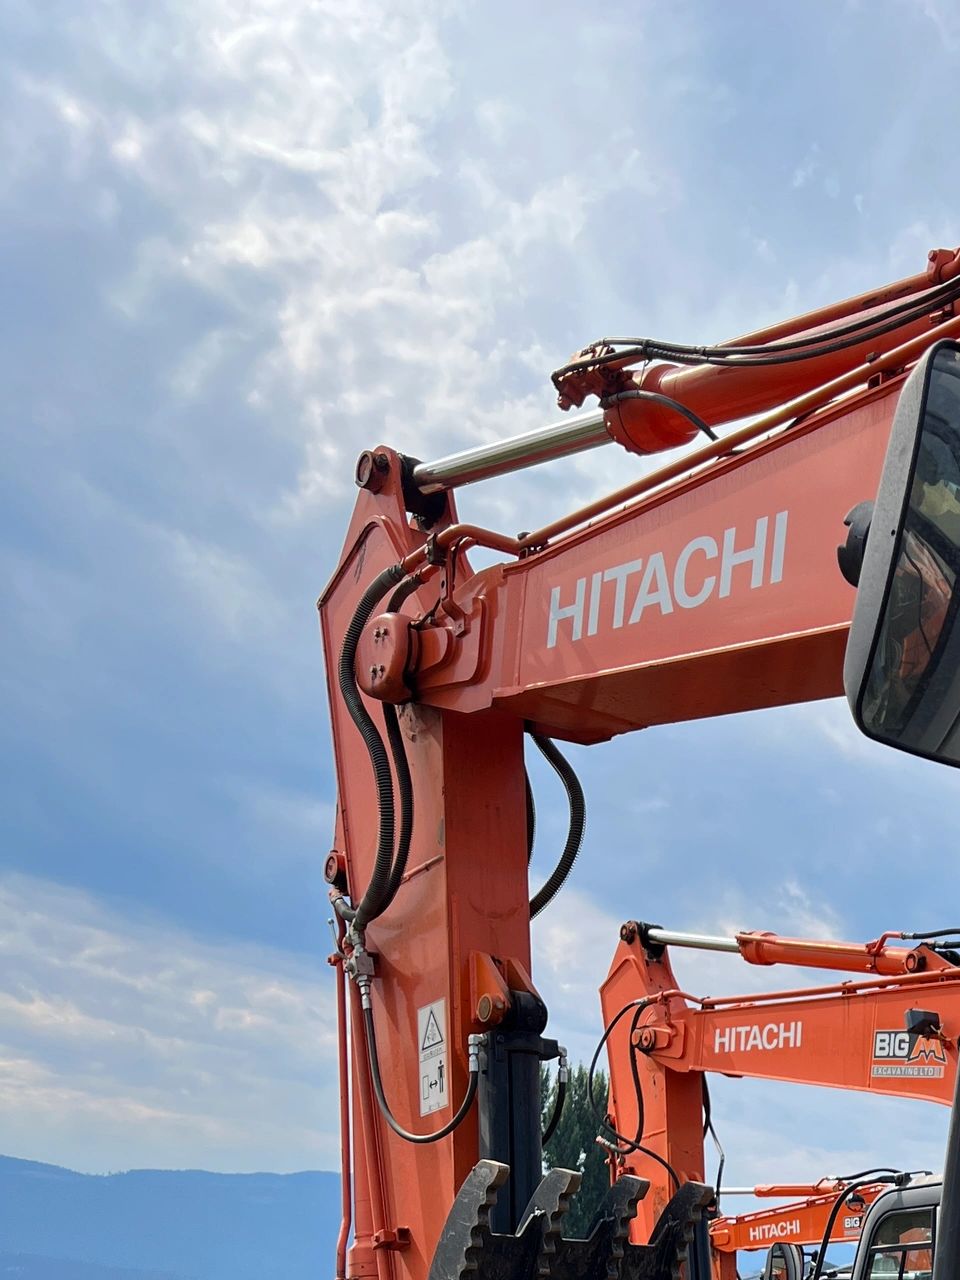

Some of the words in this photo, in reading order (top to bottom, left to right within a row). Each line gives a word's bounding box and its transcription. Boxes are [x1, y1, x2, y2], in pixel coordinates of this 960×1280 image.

[547, 510, 788, 649] HITACHI
[714, 1021, 803, 1054] HITACHI
[874, 1032, 910, 1057] BIG
[909, 1035, 945, 1061] M
[873, 1066, 919, 1076] EXCAVATING
[750, 1220, 800, 1241] HITACHI
[845, 1217, 860, 1228] BIG
